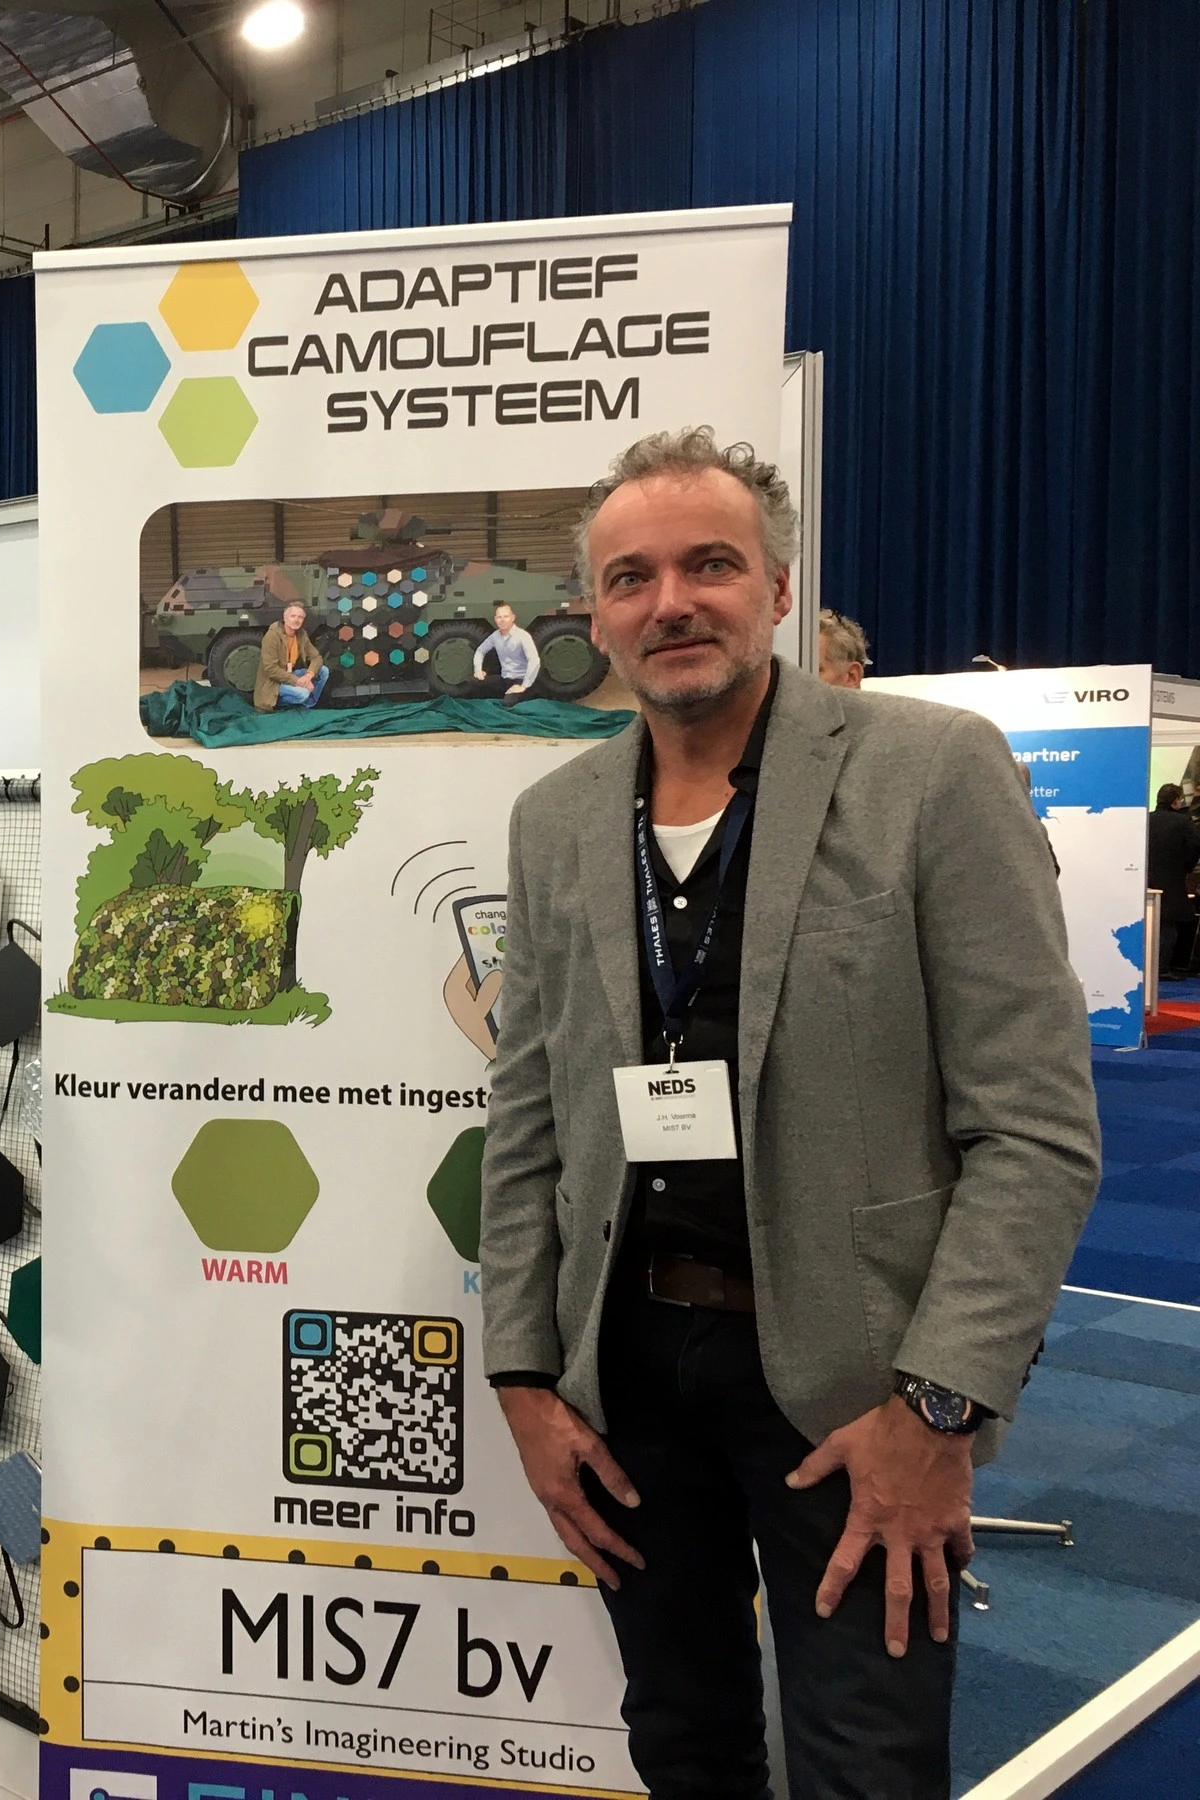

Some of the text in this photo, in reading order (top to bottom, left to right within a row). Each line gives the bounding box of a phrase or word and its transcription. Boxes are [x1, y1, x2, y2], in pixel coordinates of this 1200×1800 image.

[314, 254, 639, 315] ADAPTIEF
[247, 312, 711, 378] CAMOUFLAGE
[327, 377, 640, 433] SYSTEEM
[1074, 688, 1130, 703] VIRO
[468, 922, 506, 936] colo
[475, 910, 507, 921] chang
[650, 915, 665, 967] THALES
[54, 1073, 493, 1113] Kleur veranderd mee met ingest
[648, 1078, 696, 1096] NEDS
[201, 1258, 288, 1285] WARM
[463, 1271, 480, 1293] K
[274, 1495, 476, 1537] meer info
[221, 1588, 553, 1703] MIS7 bv
[306, 1720, 490, 1770] Imagineering
[500, 1739, 596, 1773] Studio
